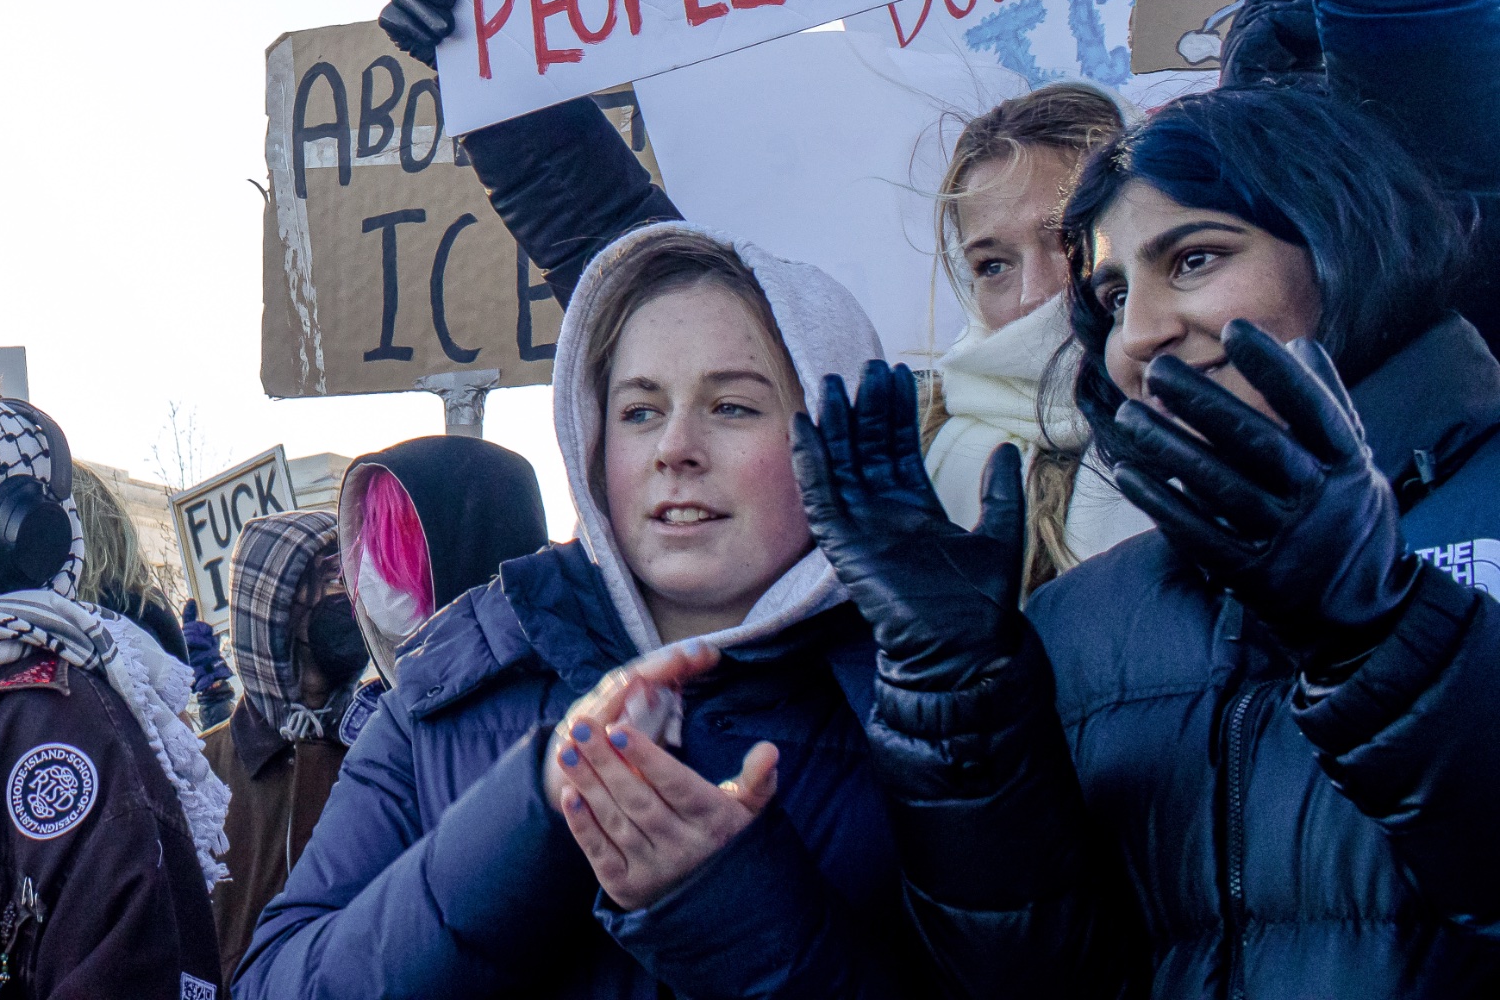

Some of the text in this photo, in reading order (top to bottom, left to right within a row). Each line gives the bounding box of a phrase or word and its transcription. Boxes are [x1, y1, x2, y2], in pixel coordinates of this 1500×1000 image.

[184, 464, 285, 564] FUCK
[1414, 540, 1473, 568] THE
[24, 749, 66, 771] ISLAND
[66, 753, 92, 795] SCHOOL
[12, 768, 28, 814] RHODE
[76, 795, 90, 812] OF
[39, 810, 79, 834] DESIGN
